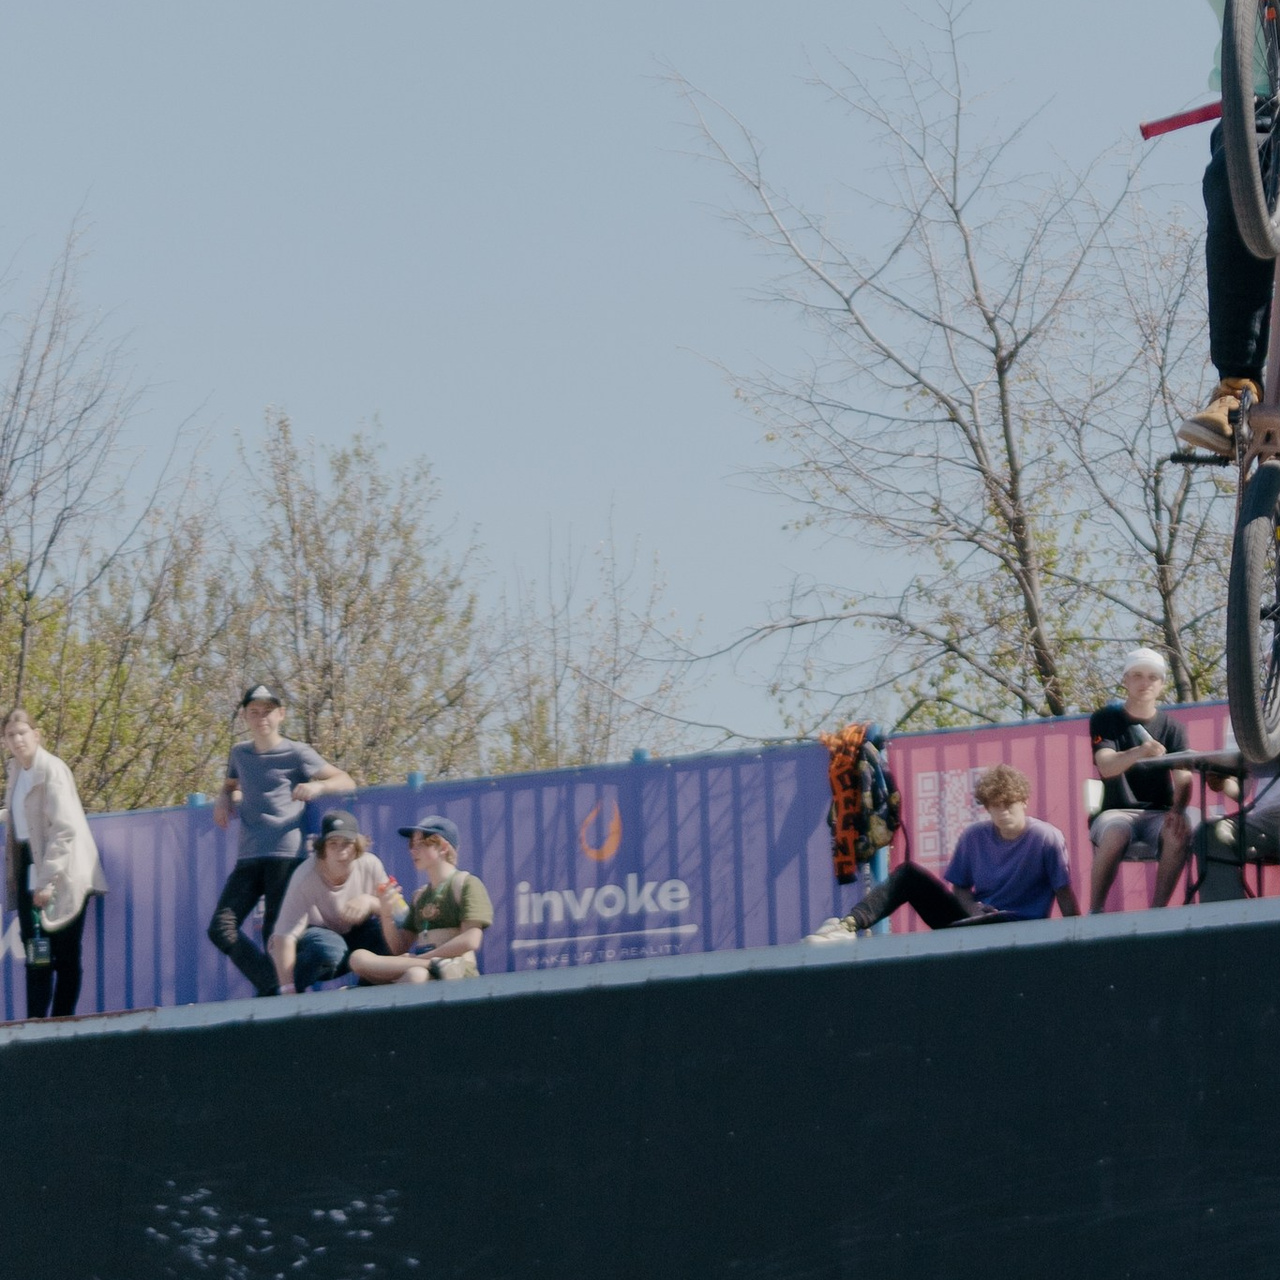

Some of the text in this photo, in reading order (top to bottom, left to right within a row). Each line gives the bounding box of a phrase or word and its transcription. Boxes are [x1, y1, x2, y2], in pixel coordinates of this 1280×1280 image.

[518, 873, 690, 924] invoke
[527, 944, 683, 966] WAKE UP TO REALITY
